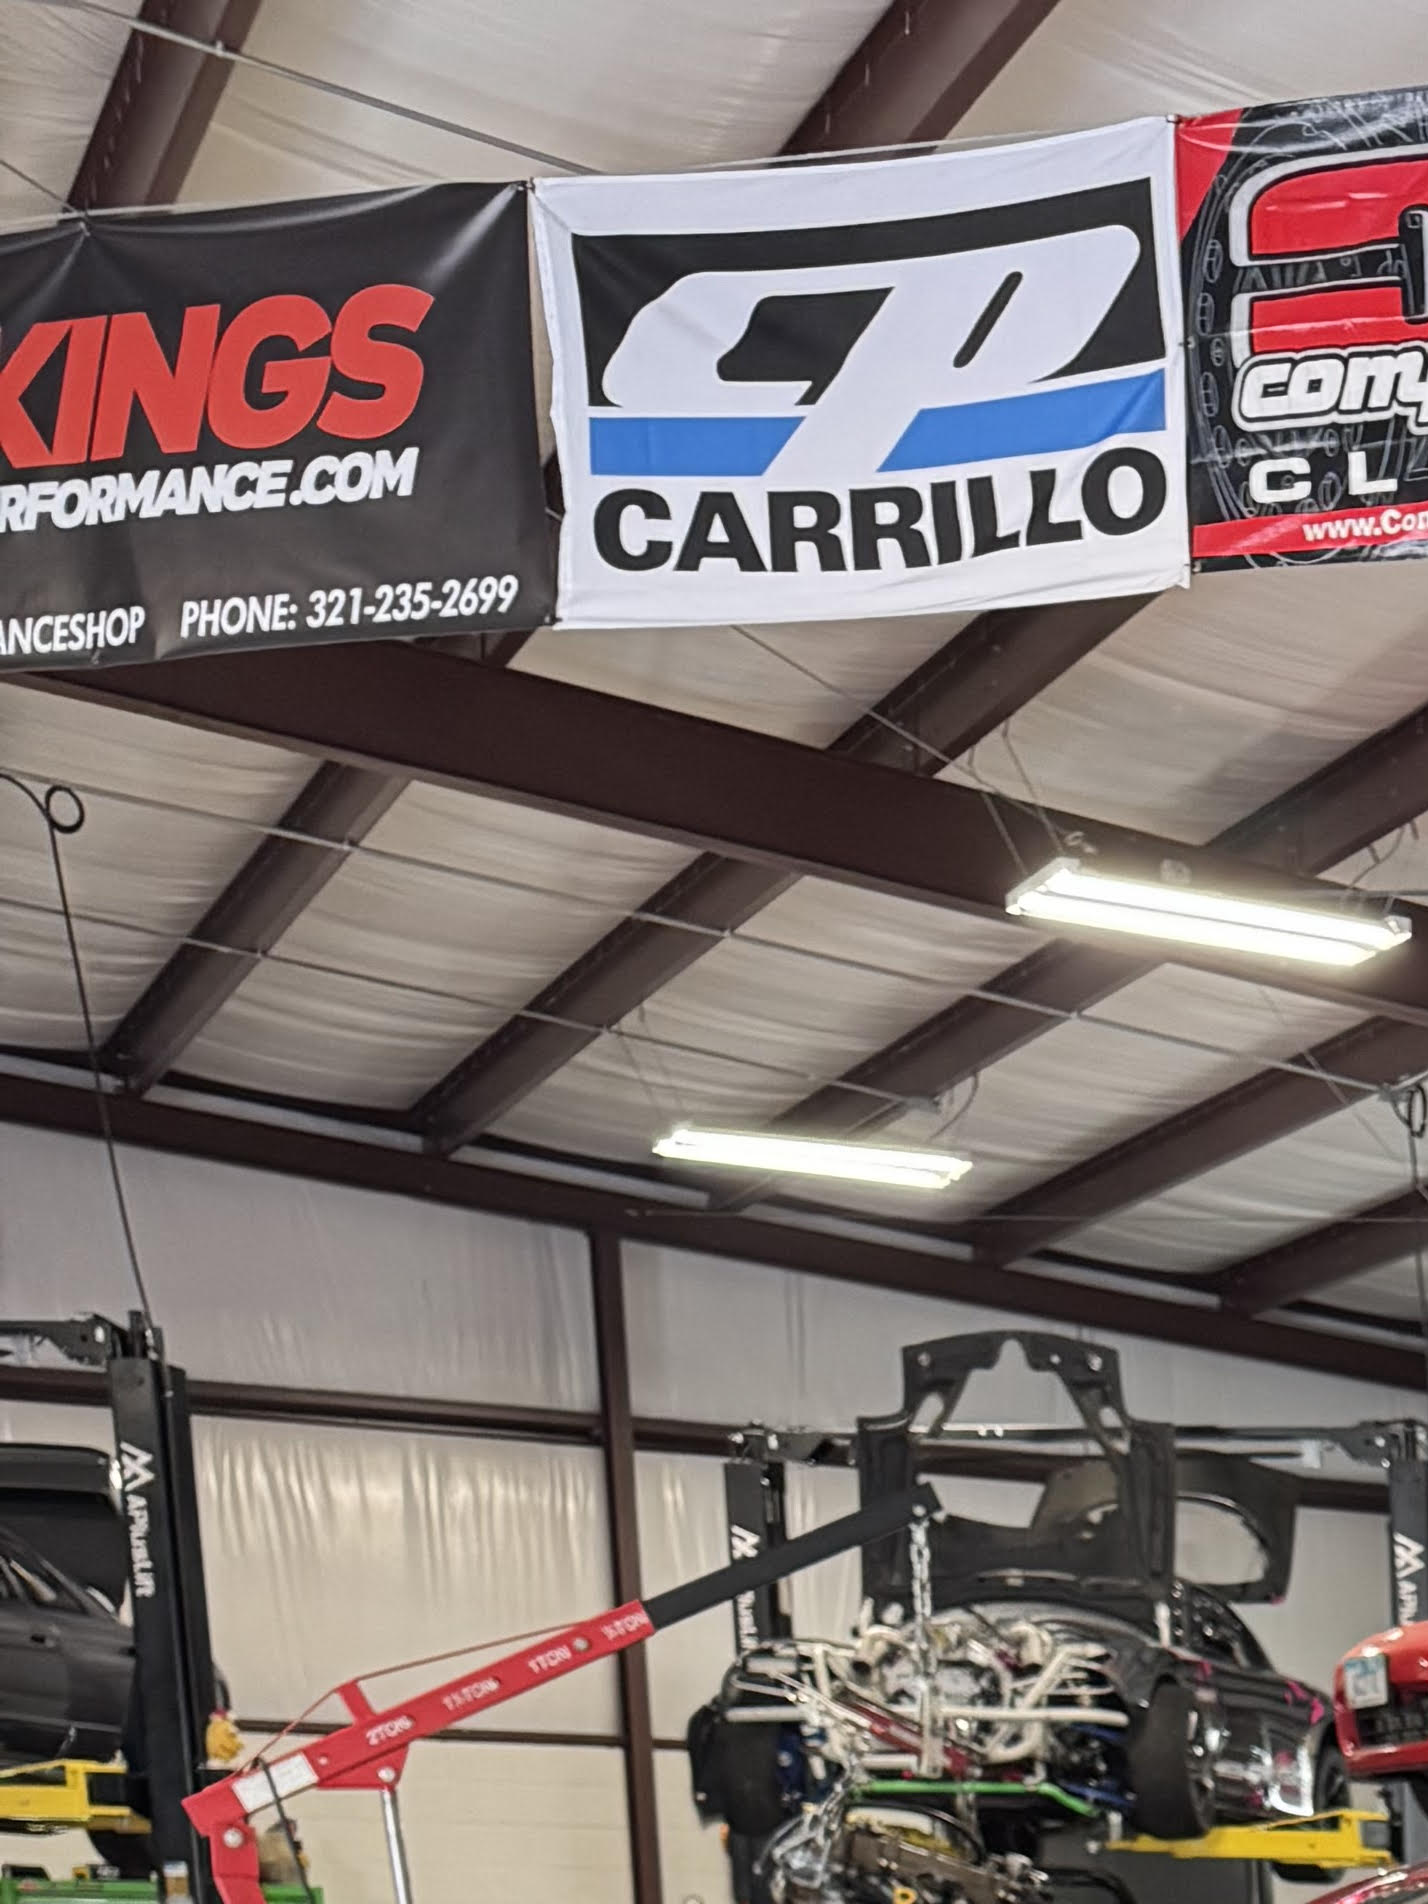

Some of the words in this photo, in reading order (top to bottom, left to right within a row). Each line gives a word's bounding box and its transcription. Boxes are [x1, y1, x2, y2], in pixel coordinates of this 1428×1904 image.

[593, 447, 1167, 572] CARRILLO
[180, 598, 299, 639] PHONE:
[305, 575, 519, 628] 321-235-2699
